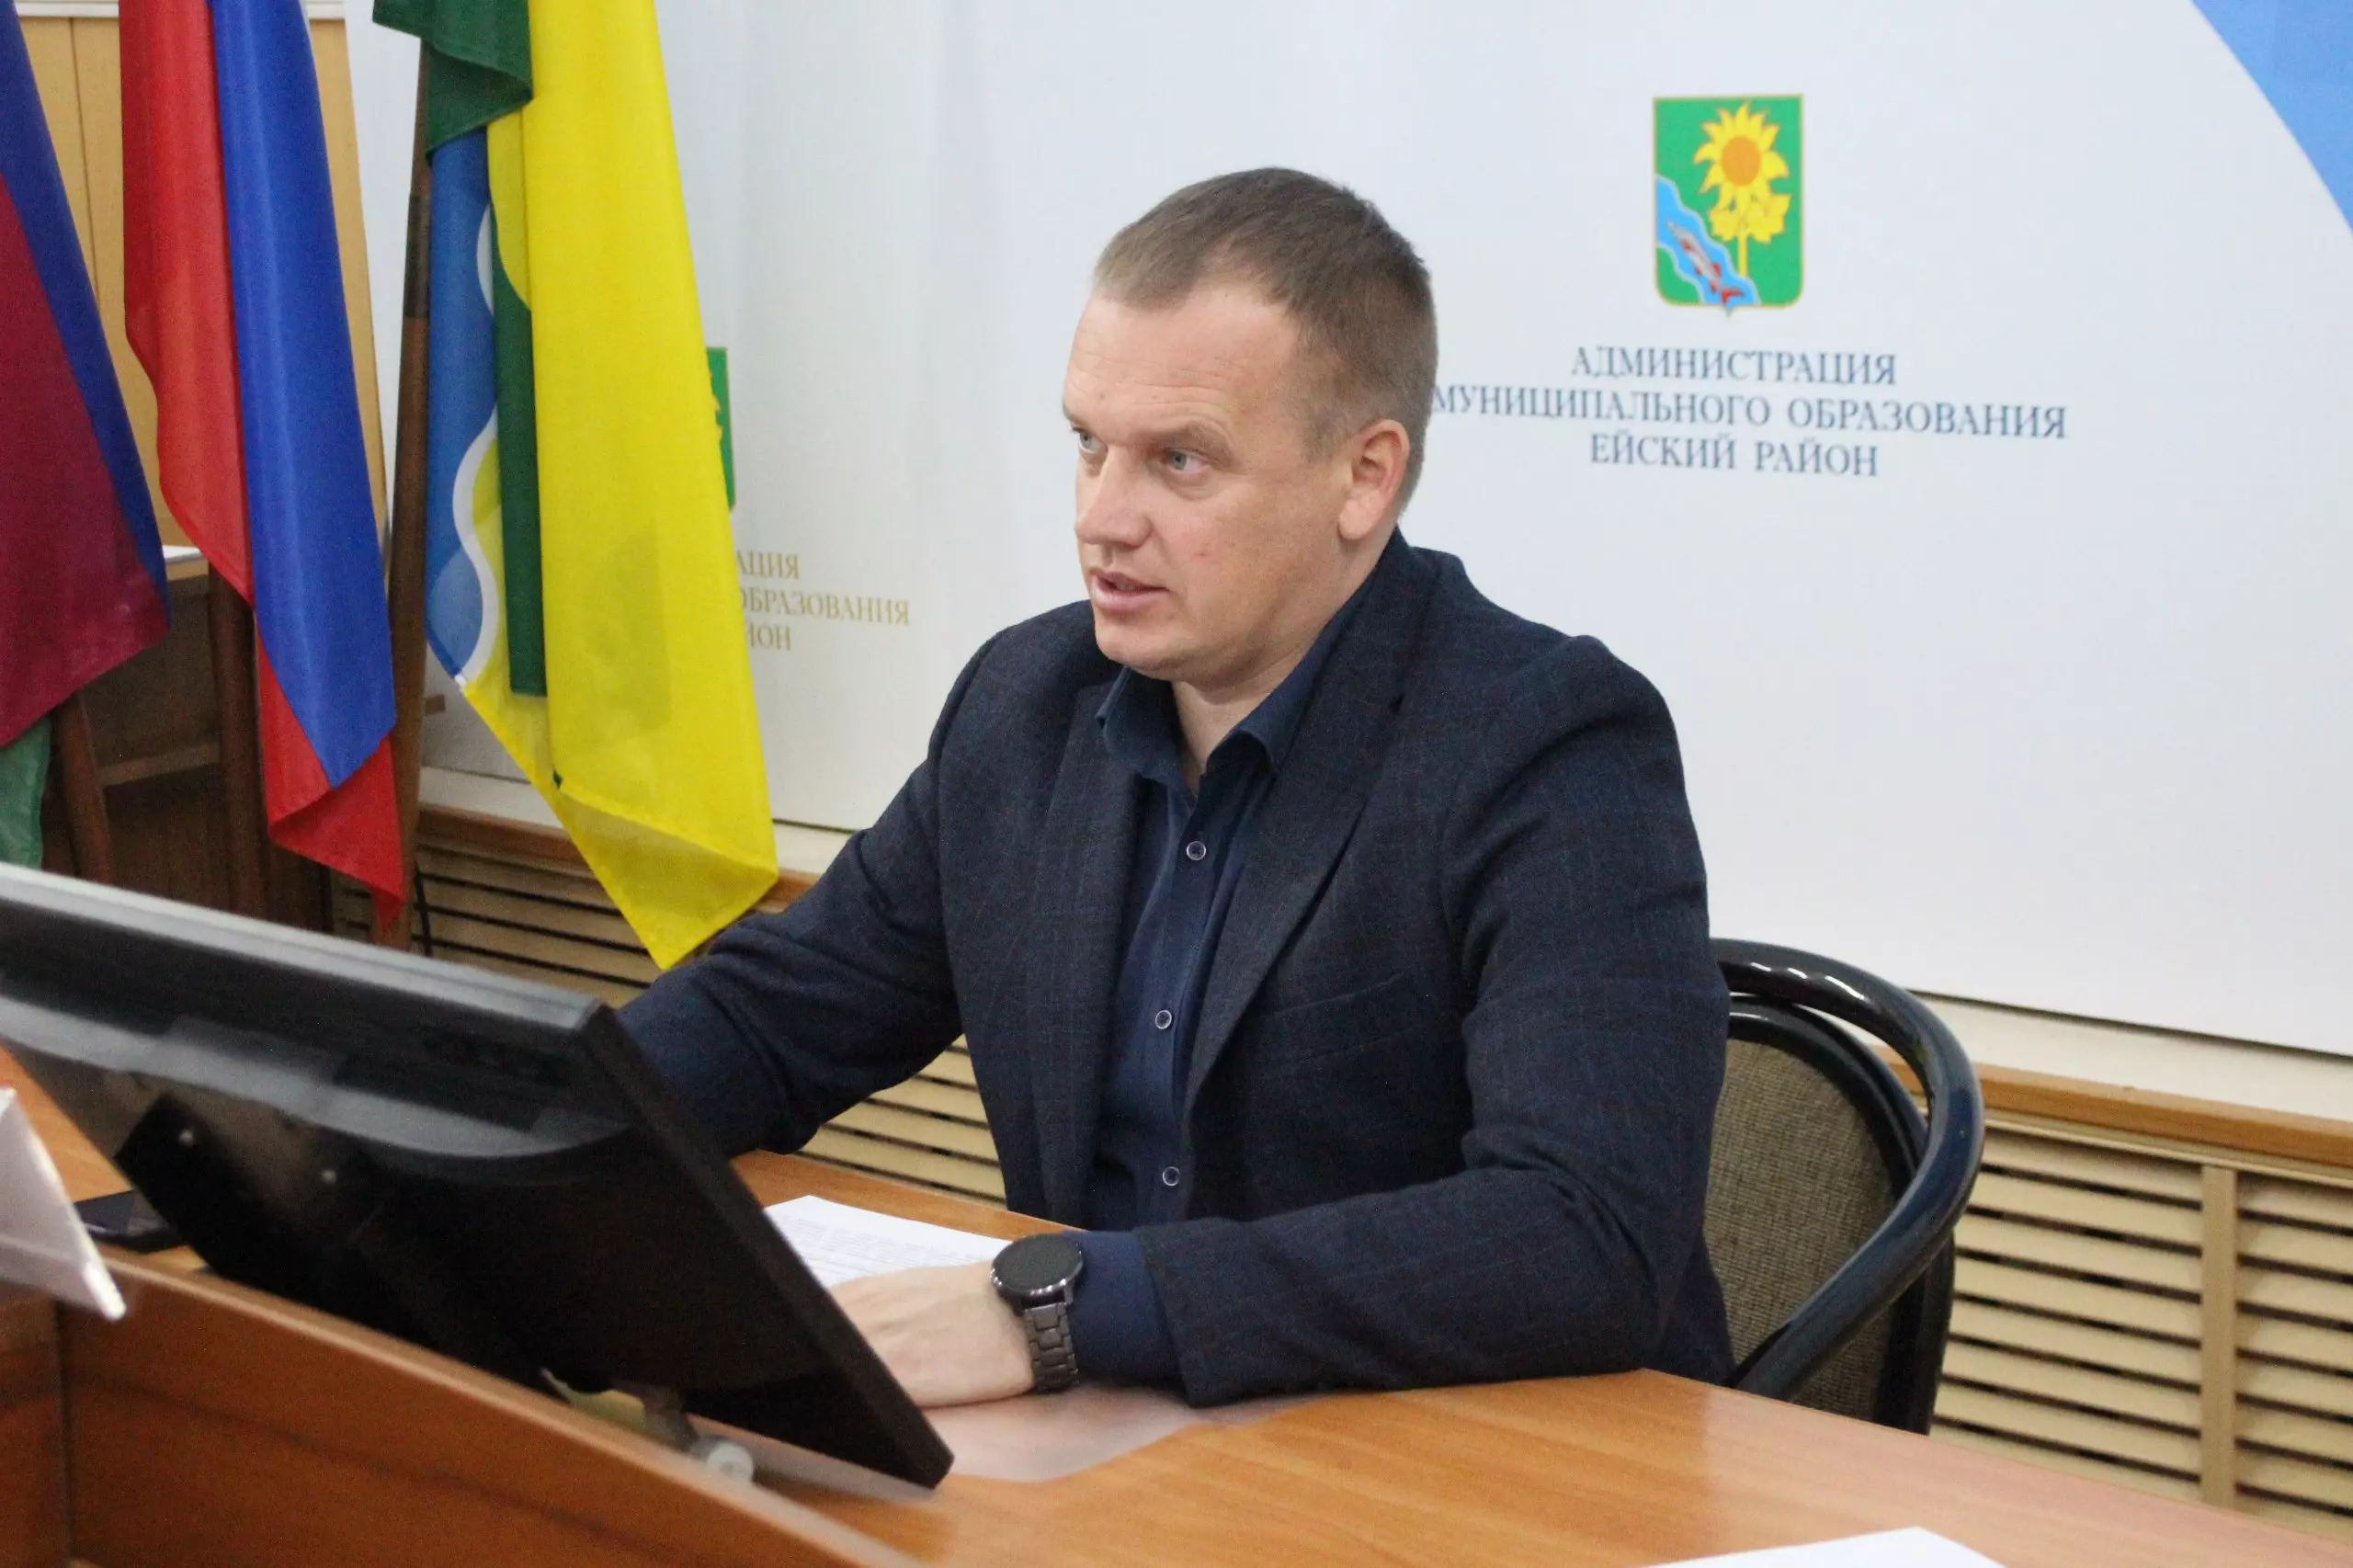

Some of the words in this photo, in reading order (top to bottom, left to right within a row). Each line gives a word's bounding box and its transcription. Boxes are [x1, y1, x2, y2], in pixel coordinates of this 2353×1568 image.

[1571, 345, 1896, 386] АДМИНИСТРАЦИЯ
[1432, 384, 1770, 426] МУНИЦИПАЛЬНОГО
[1787, 396, 2068, 439] ОБРАЗОВАНИЯ
[1591, 427, 1735, 471] ЕЙСКИЙ
[1754, 436, 1878, 477] РАЙОН
